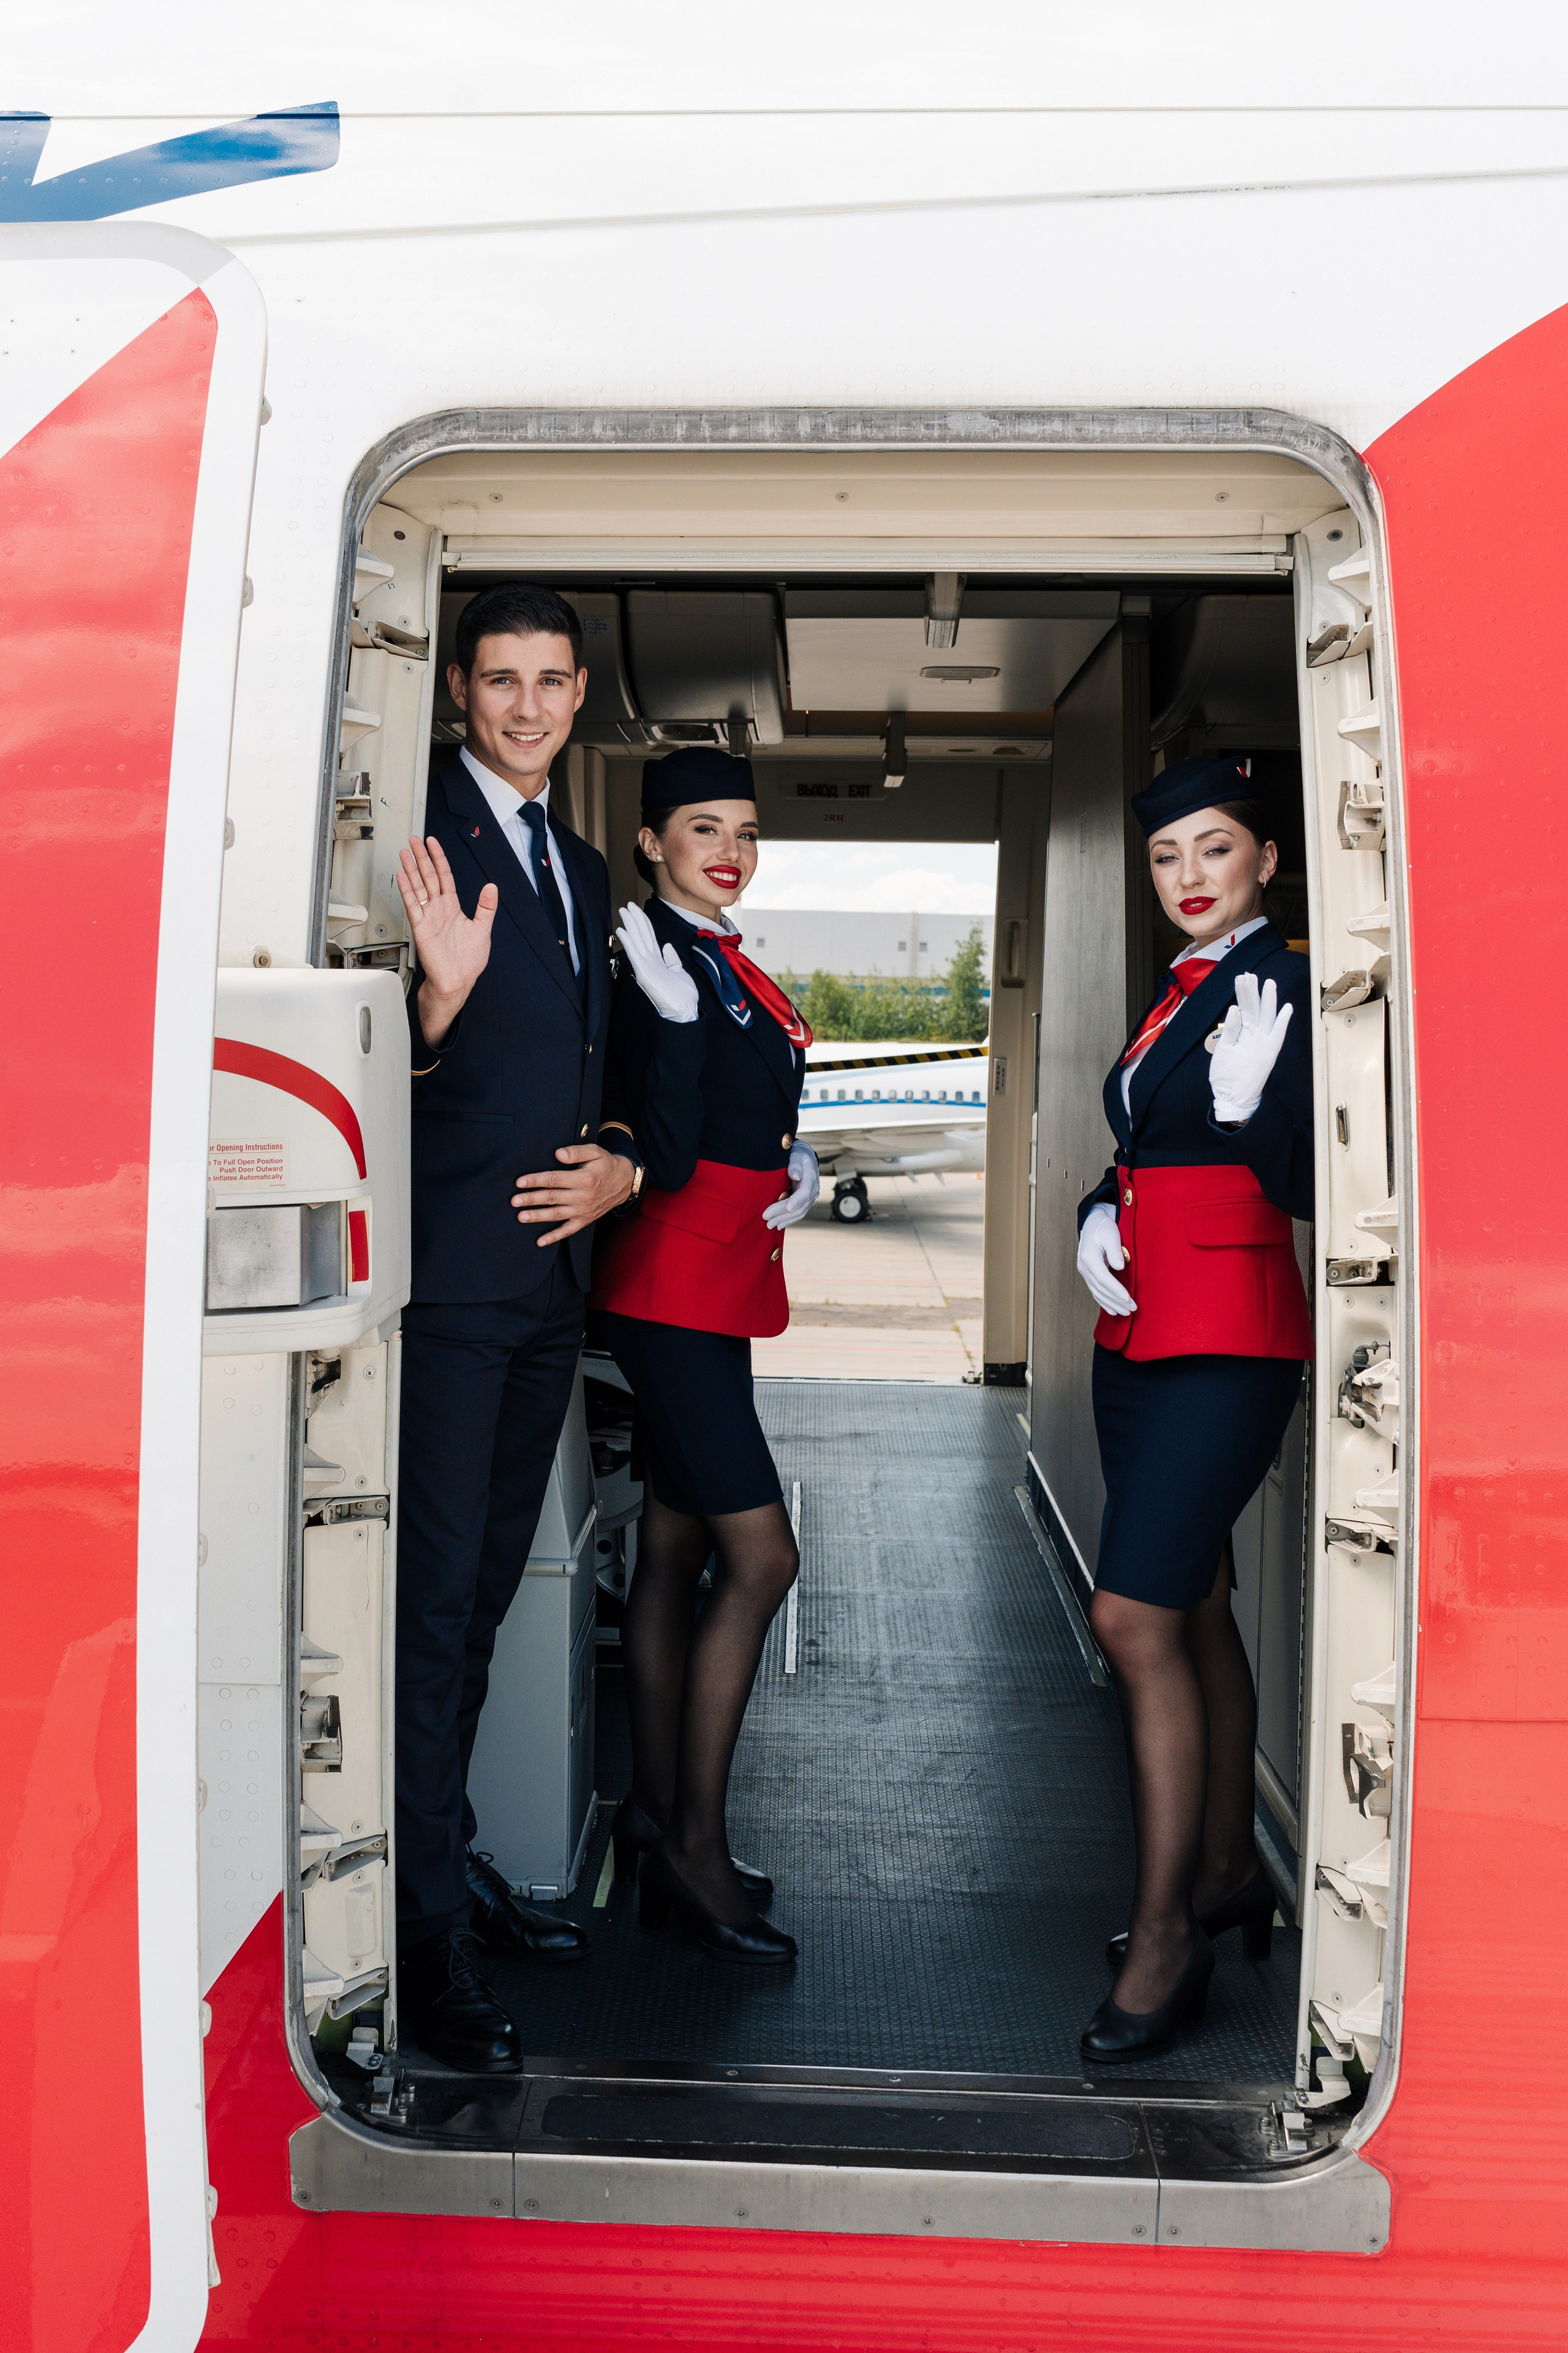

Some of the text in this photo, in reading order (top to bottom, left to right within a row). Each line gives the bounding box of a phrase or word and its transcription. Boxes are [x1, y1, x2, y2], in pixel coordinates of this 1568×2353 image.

[797, 784, 872, 798] ВЫХОД EXIT
[216, 1144, 243, 1152] Opening
